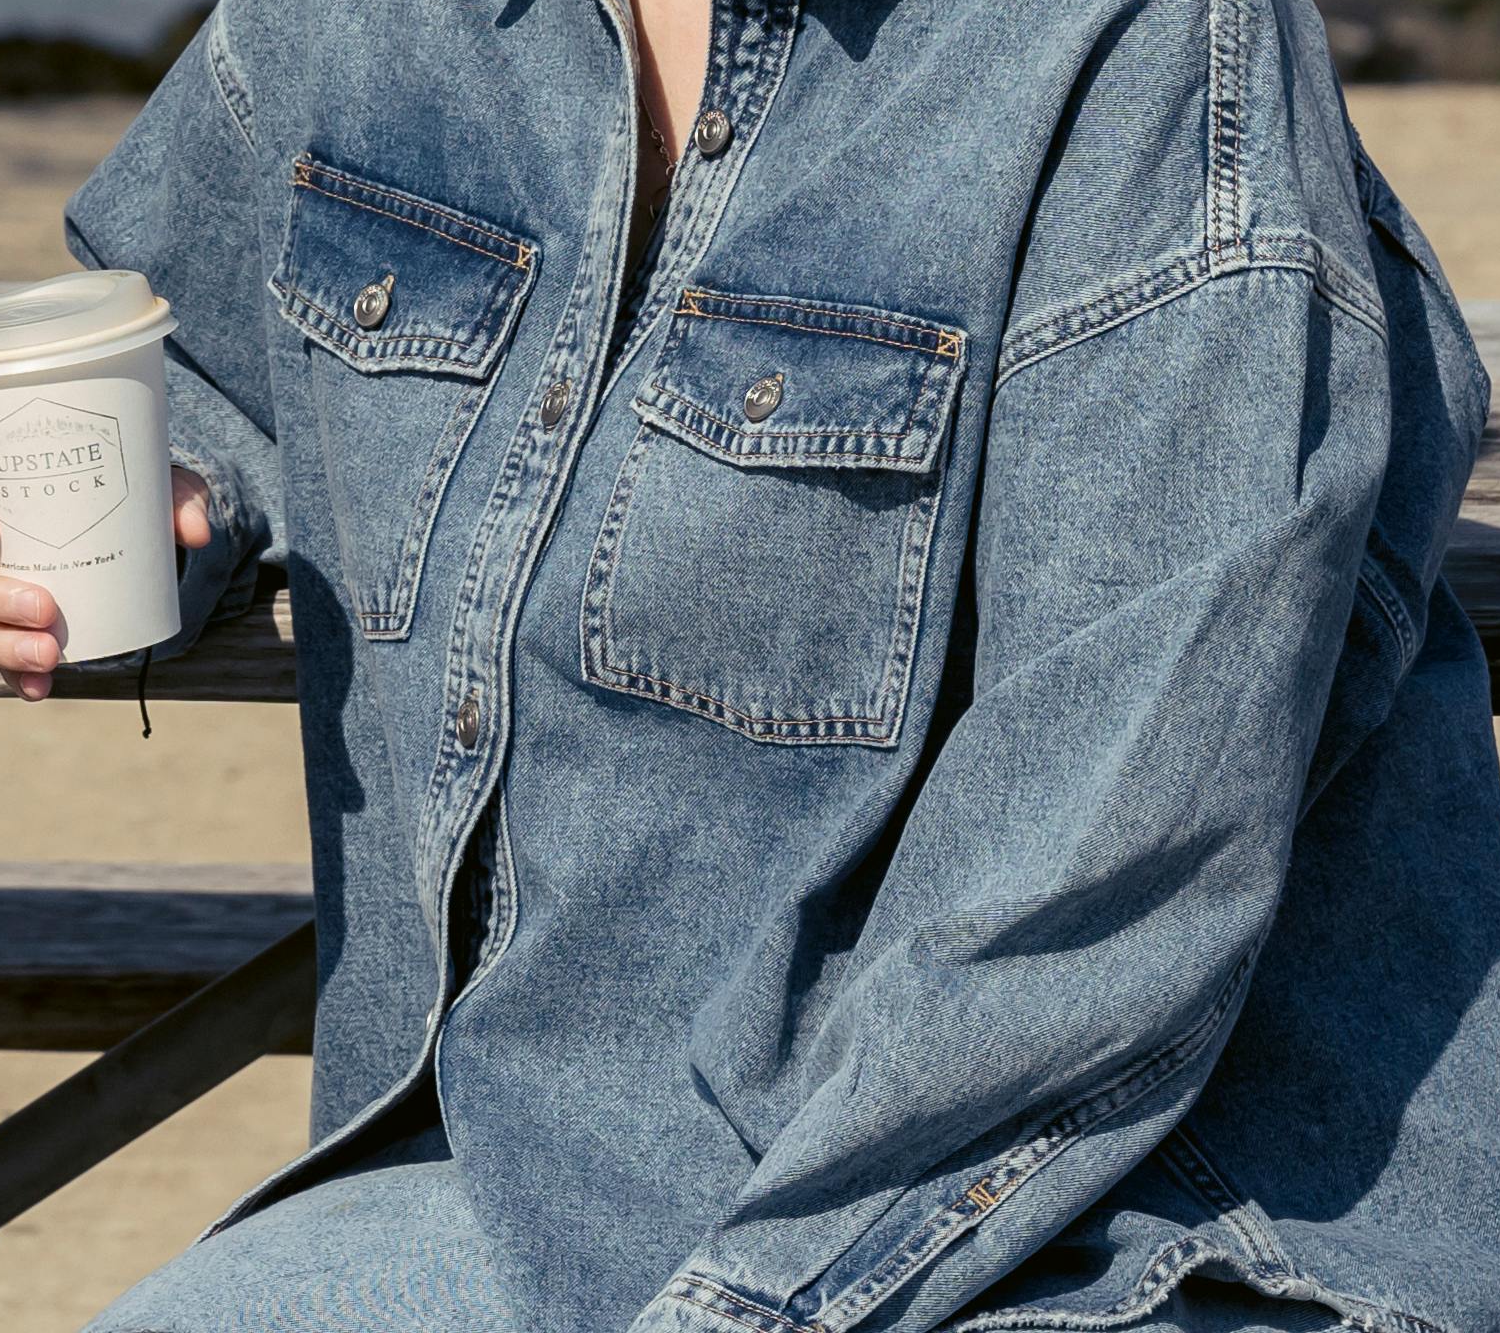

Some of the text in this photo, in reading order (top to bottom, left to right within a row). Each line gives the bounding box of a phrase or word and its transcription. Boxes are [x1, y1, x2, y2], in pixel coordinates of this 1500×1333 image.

[2, 474, 105, 498] STOCK
[33, 564, 56, 572] Made
[60, 562, 69, 572] in
[72, 559, 92, 569] New
[94, 552, 116, 565] York
